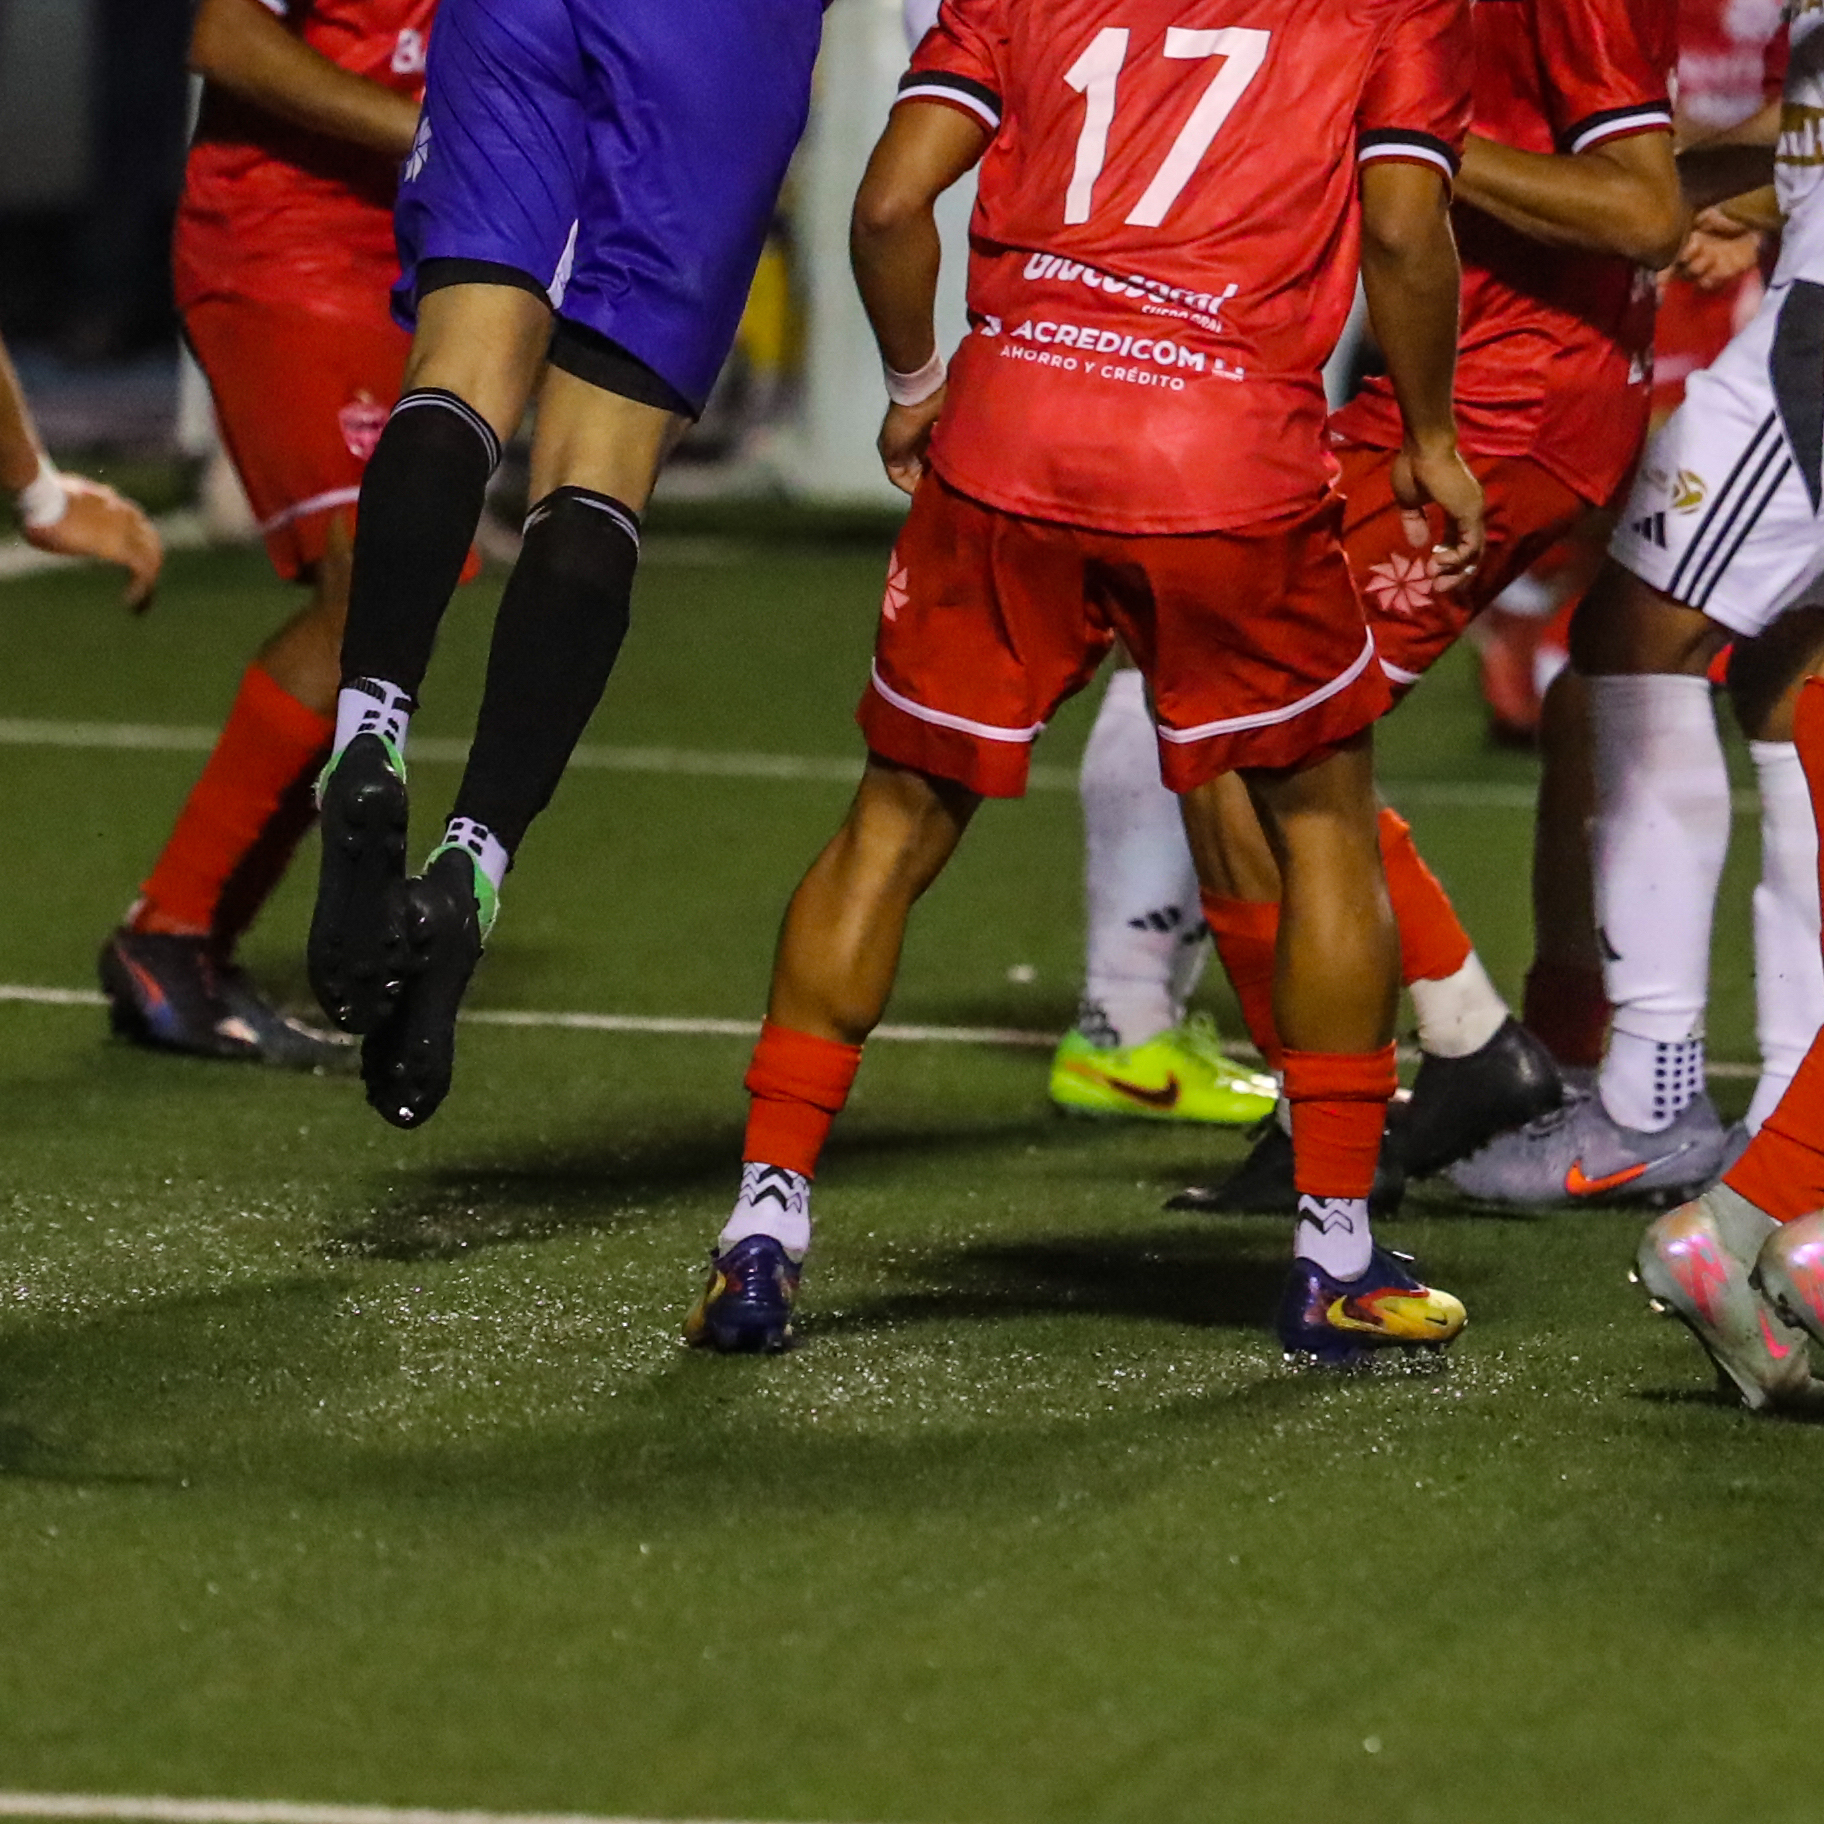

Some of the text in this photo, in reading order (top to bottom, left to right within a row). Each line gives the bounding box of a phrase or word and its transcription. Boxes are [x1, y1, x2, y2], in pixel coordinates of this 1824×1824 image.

[1062, 26, 1271, 228] 17
[1000, 344, 1185, 391] AHORRO Y CRÉDITO
[1010, 319, 1206, 372] ACREDICOM
